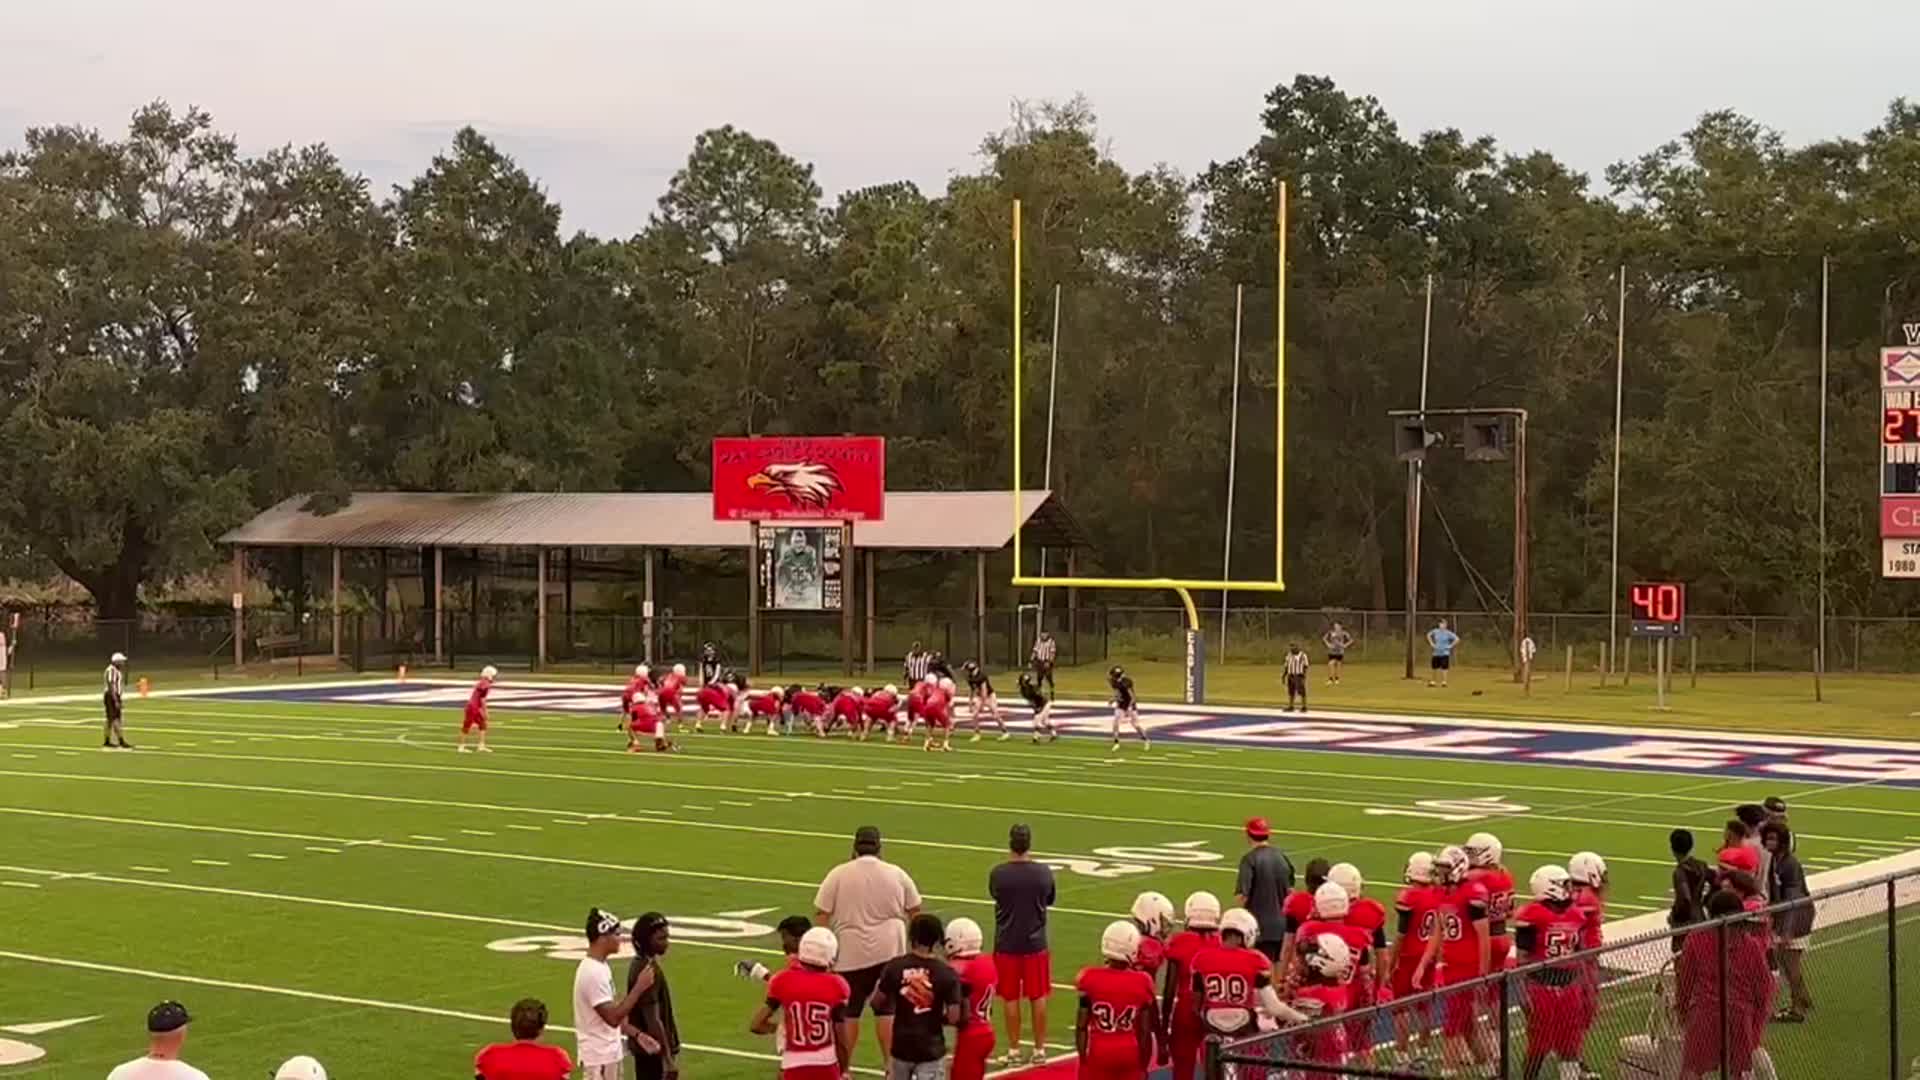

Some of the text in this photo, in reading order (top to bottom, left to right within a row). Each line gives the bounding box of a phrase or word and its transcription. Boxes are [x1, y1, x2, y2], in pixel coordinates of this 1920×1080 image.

[1887, 445, 1920, 464] DOW
[1633, 586, 1677, 620] 40
[1187, 631, 1195, 703] EAGLES
[789, 1001, 831, 1046] 15
[1091, 1001, 1137, 1032] 34
